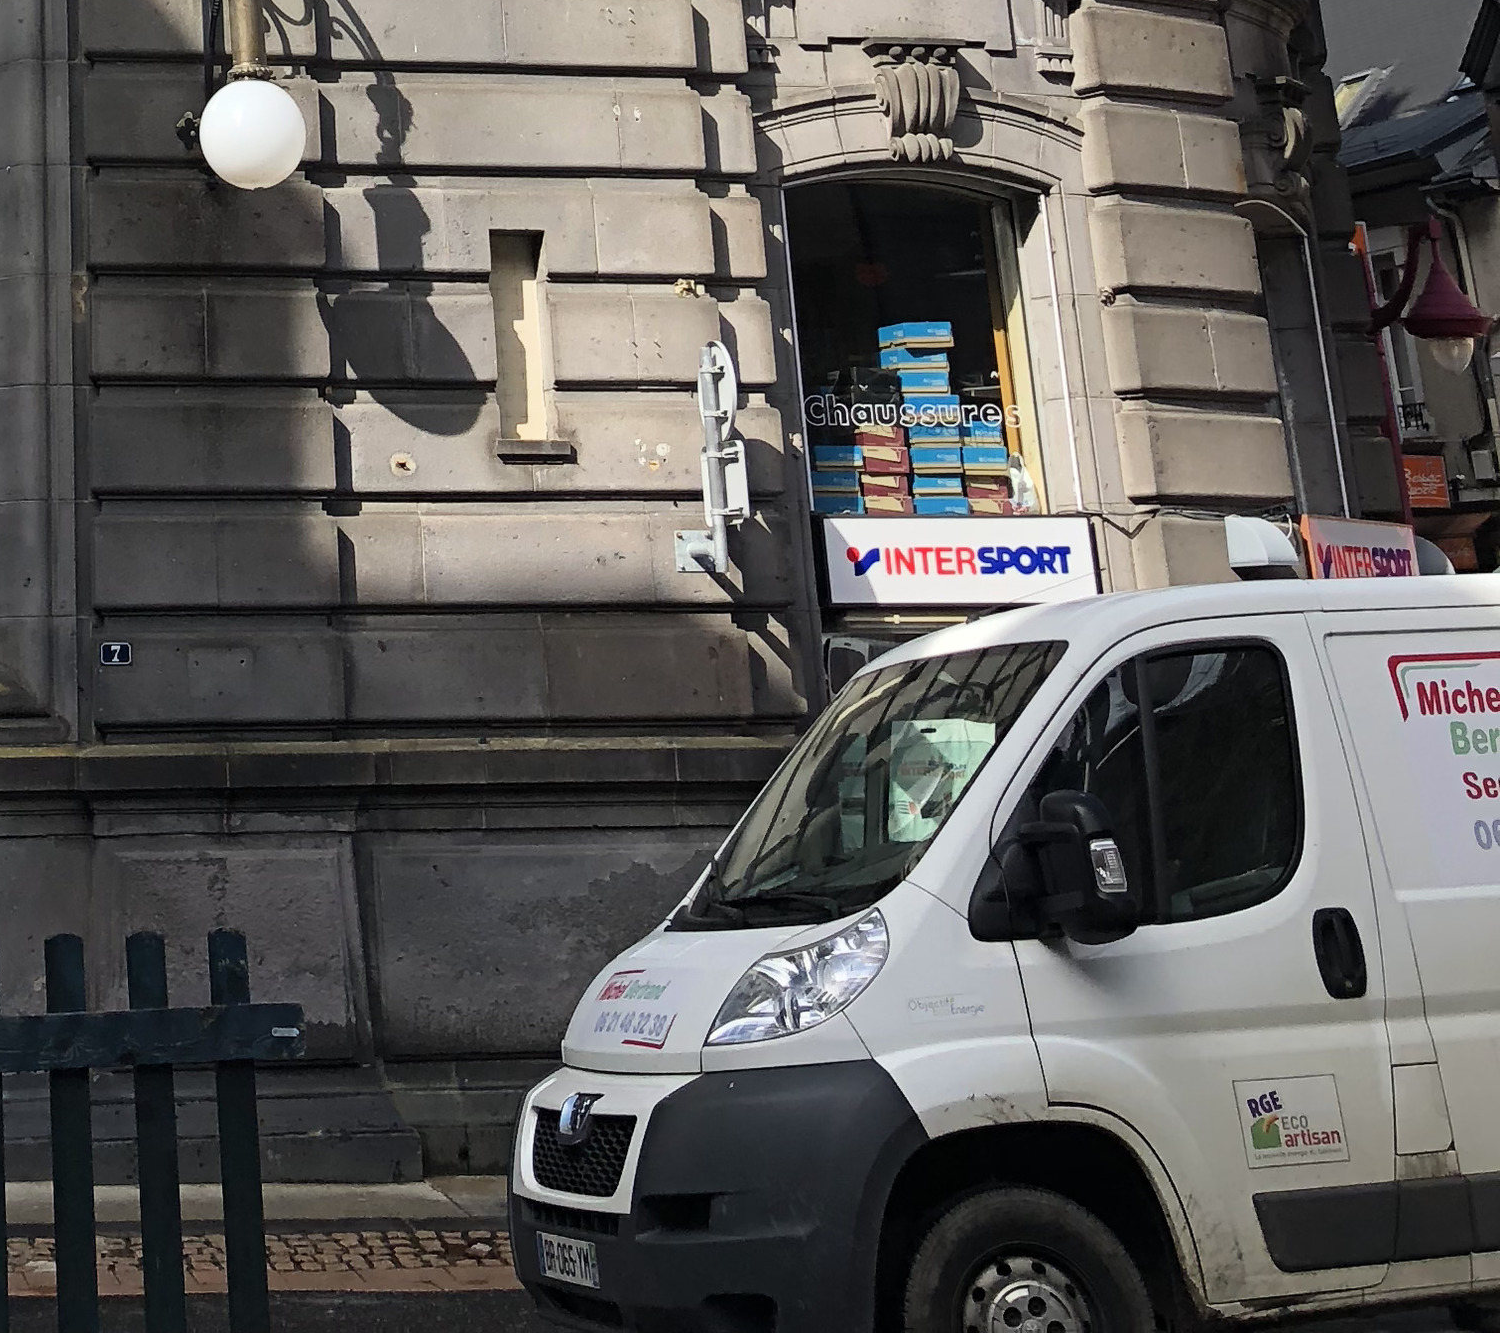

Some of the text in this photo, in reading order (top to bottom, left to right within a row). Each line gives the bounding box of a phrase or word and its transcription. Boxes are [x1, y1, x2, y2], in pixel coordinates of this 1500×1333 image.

[802, 393, 1022, 428] Chaussures
[884, 546, 1071, 575] INTERSPORT
[1332, 545, 1413, 577] INTERSPORT
[110, 645, 121, 662] 7
[1462, 771, 1500, 800] Se
[633, 1012, 652, 1035] 32
[1246, 1090, 1283, 1119] RGE
[1281, 1115, 1309, 1130] ECO
[1284, 1129, 1342, 1148] artisan
